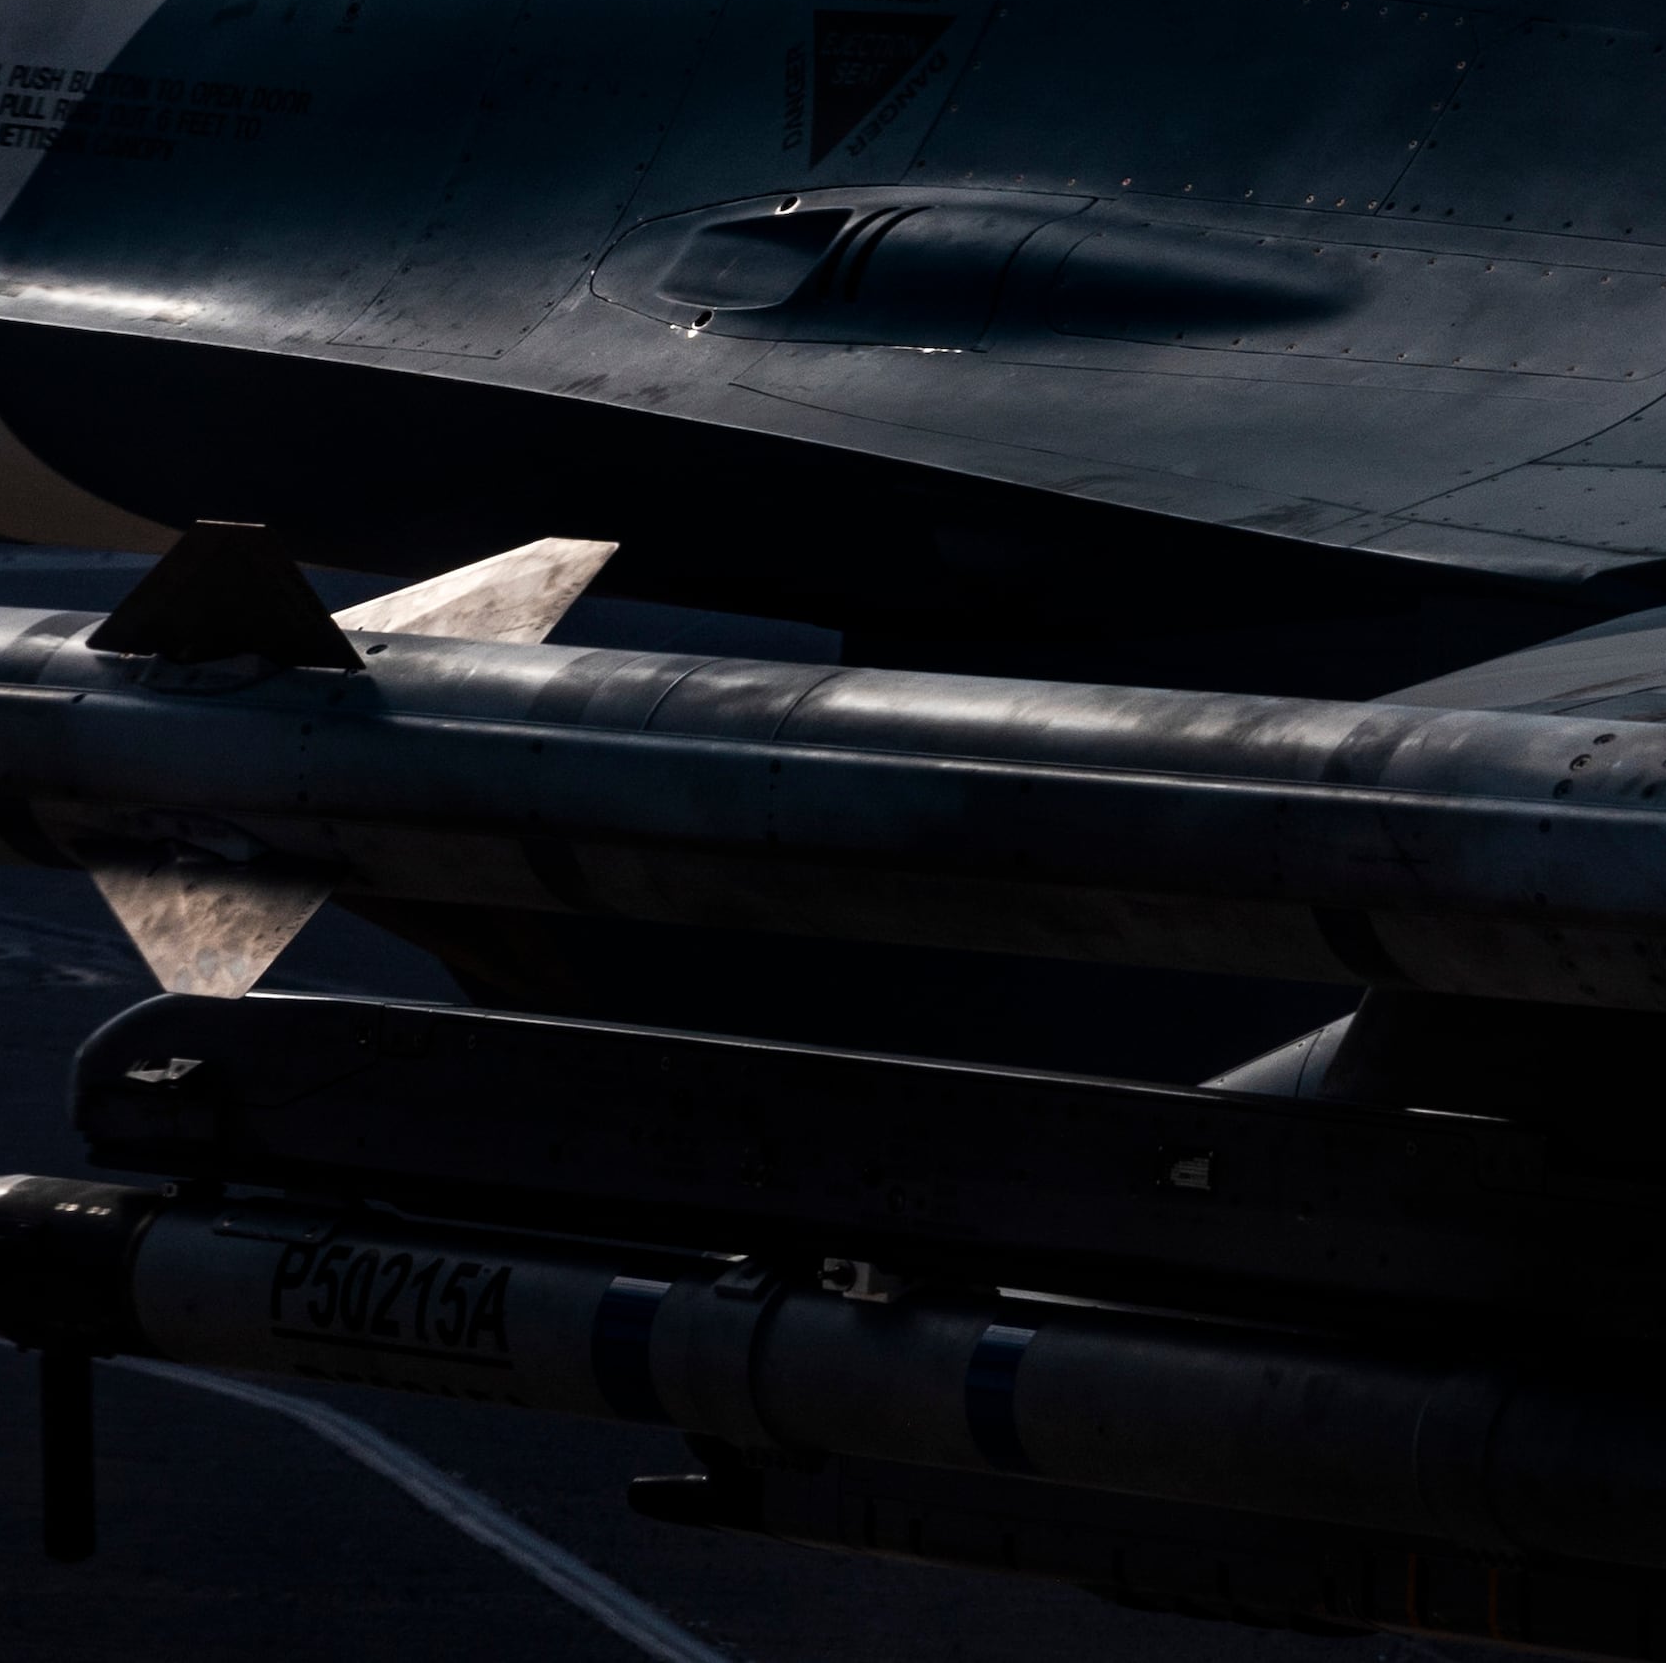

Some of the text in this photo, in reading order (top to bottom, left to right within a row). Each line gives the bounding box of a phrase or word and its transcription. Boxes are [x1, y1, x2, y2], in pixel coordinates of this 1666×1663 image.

[9, 65, 66, 92] PUSH
[69, 71, 151, 97] BUTTON
[156, 77, 185, 102] TO
[192, 81, 247, 108] OPEN
[252, 87, 313, 114] DOOR
[783, 42, 806, 151] DANGER
[830, 62, 888, 89] SEAT
[846, 49, 950, 156] DANGER
[109, 104, 151, 127] OUT
[177, 111, 227, 136] FEET
[233, 117, 262, 140] TO
[270, 1241, 513, 1353] P50215A
